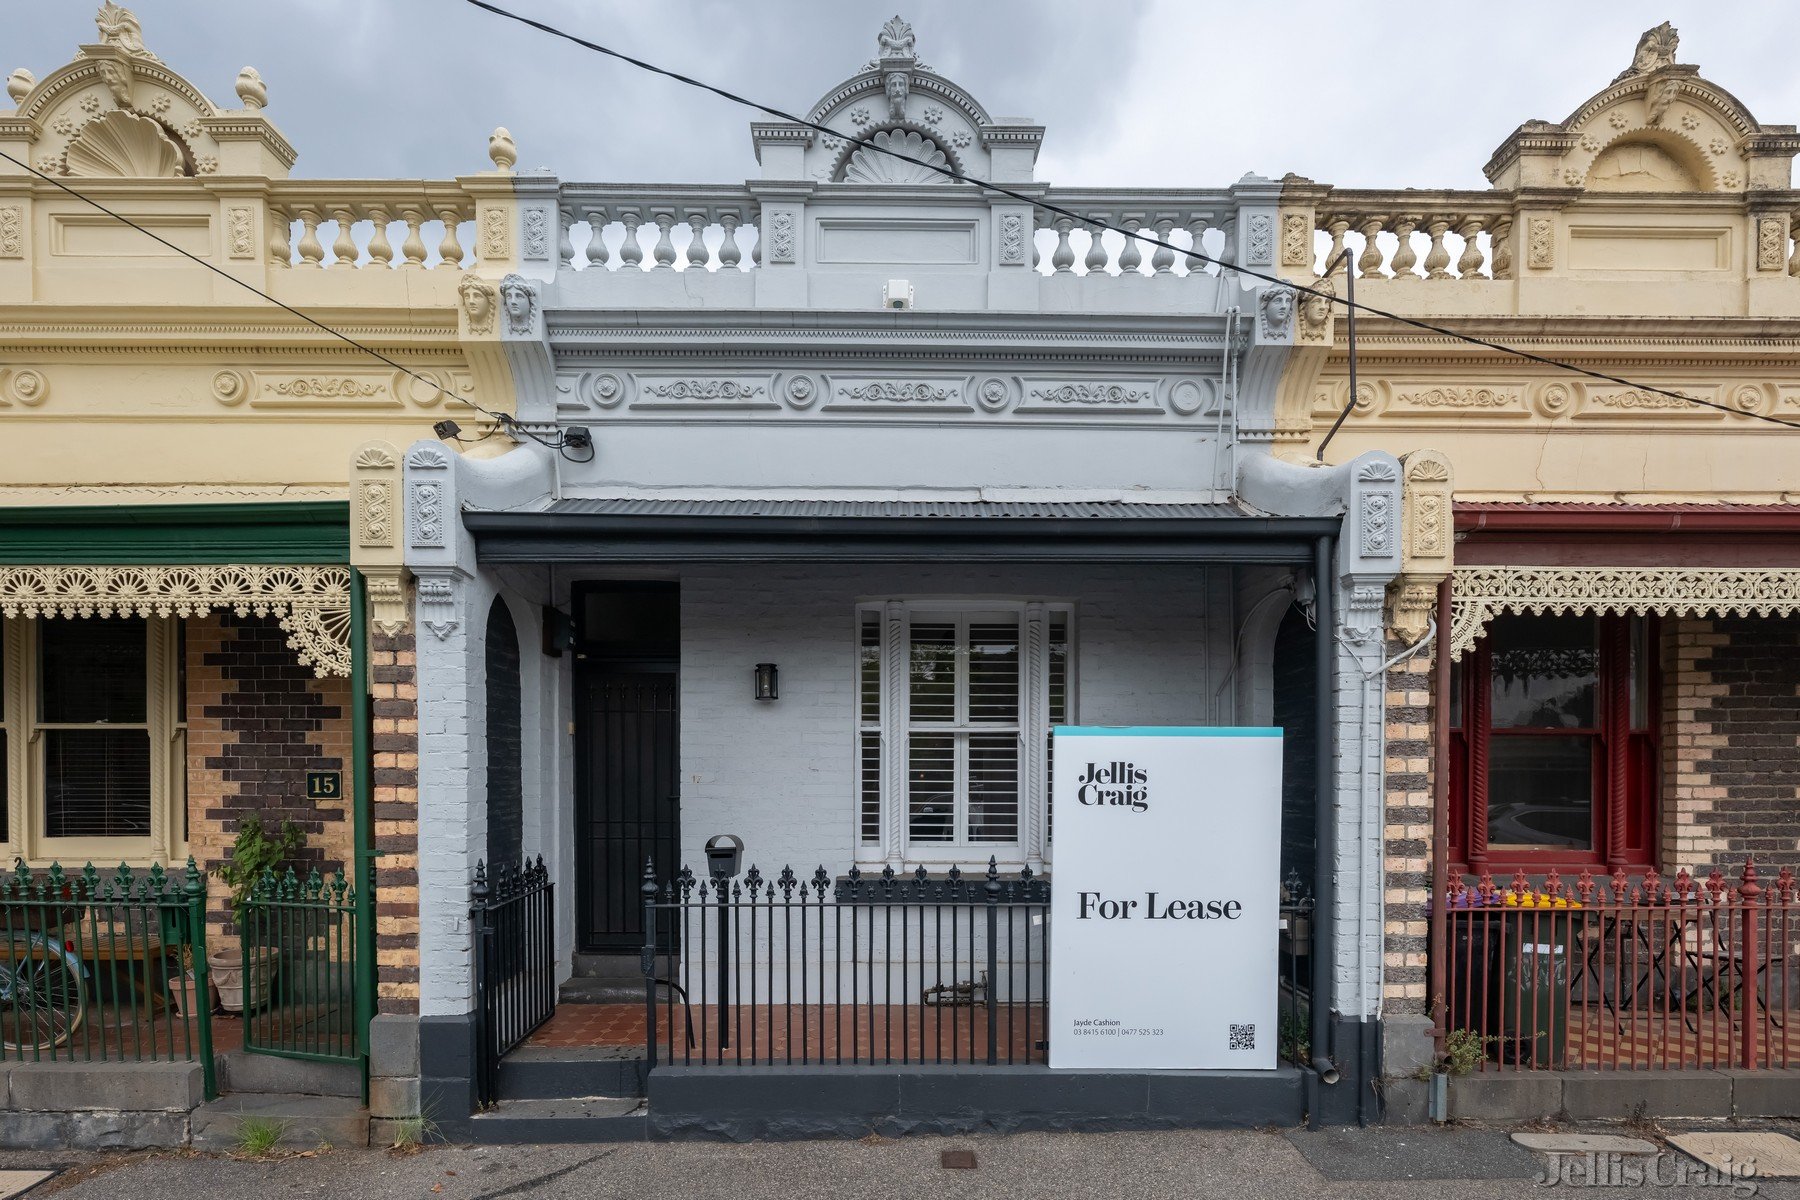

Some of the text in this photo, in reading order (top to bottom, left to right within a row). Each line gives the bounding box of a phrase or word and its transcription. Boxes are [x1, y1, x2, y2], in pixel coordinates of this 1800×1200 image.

[1078, 761, 1148, 784] Jellis
[312, 777, 335, 794] 15
[1078, 784, 1149, 813] Craig
[1076, 891, 1242, 920] For Lease
[1073, 1019, 1092, 1027] Jayde
[1073, 1028, 1082, 1036] 03
[1083, 1028, 1099, 1036] 8415
[1100, 1028, 1116, 1036] 6100
[1121, 1028, 1137, 1036] 0477
[1138, 1028, 1150, 1036] 525
[1152, 1028, 1164, 1036] 323
